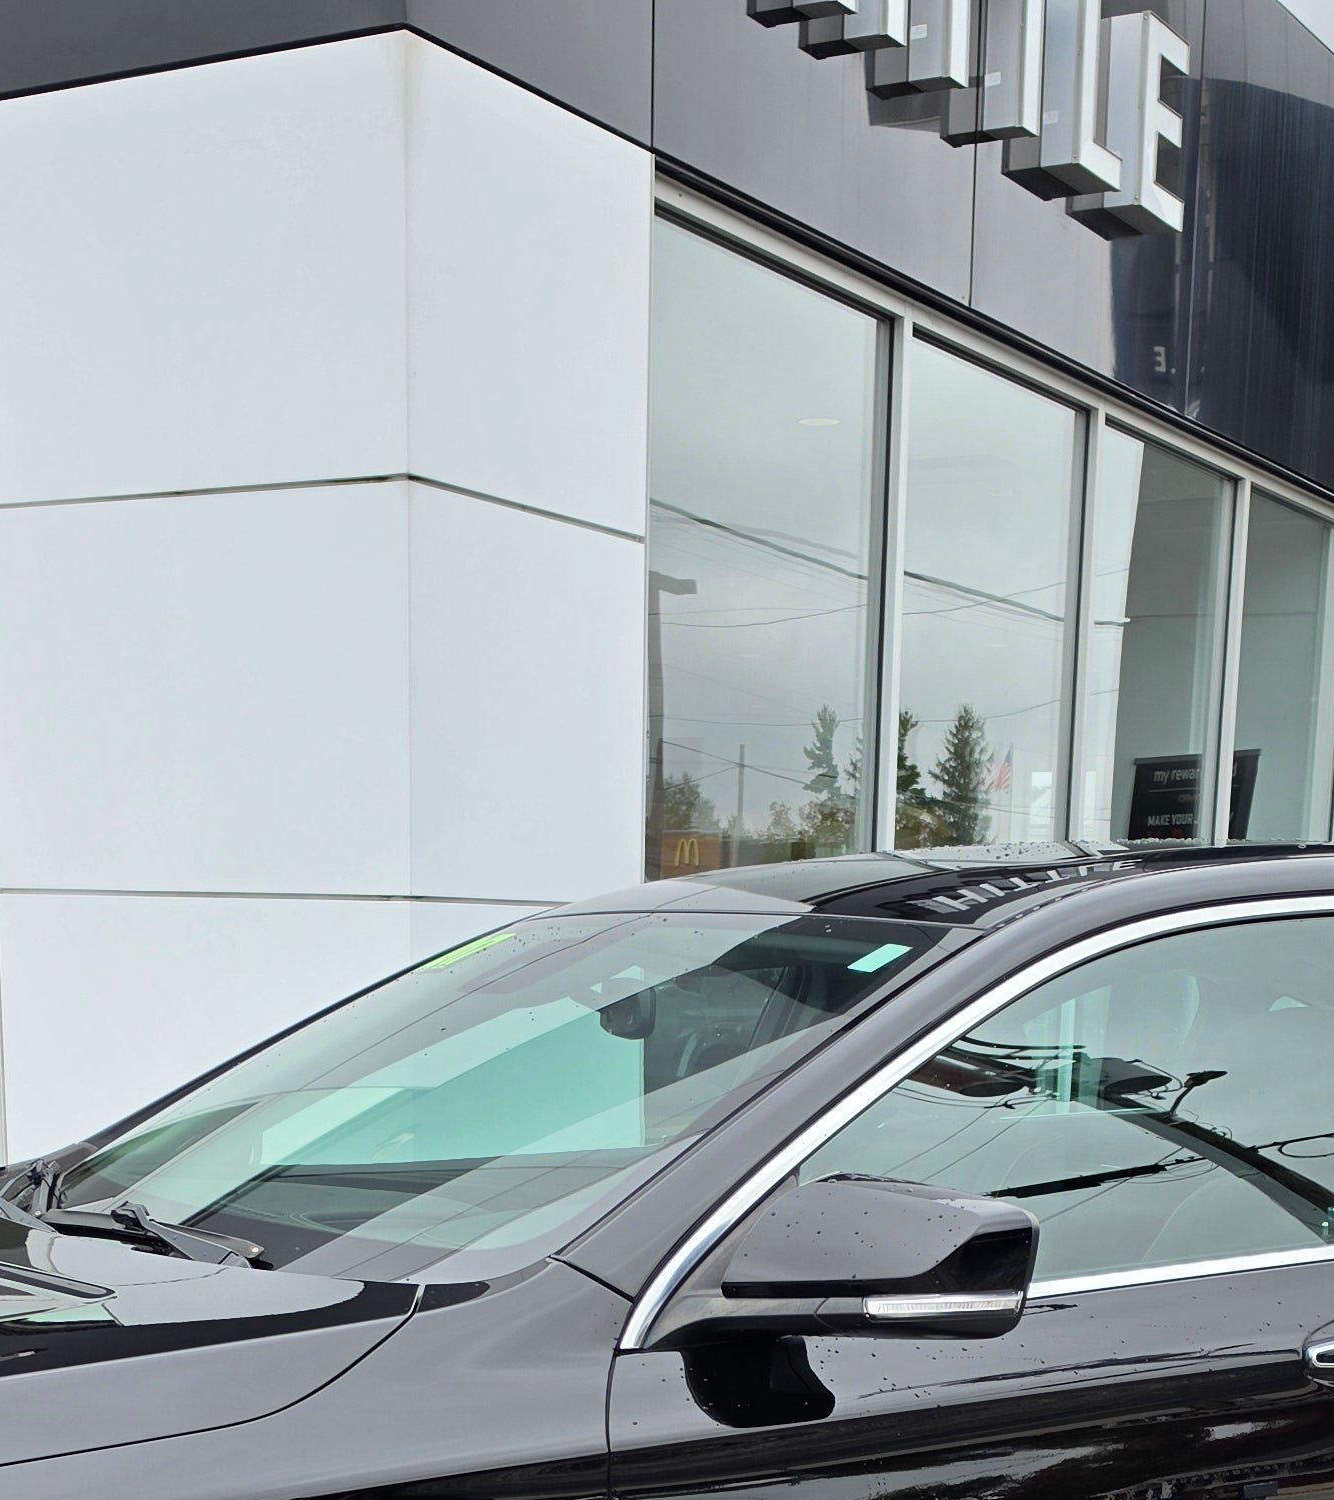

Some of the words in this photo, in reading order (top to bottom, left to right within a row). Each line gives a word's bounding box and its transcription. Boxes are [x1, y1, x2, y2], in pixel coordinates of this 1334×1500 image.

[1154, 769, 1169, 784] my
[1171, 767, 1202, 781] rewar
[1147, 814, 1170, 827] MAKE
[1172, 813, 1194, 825] YOUR
